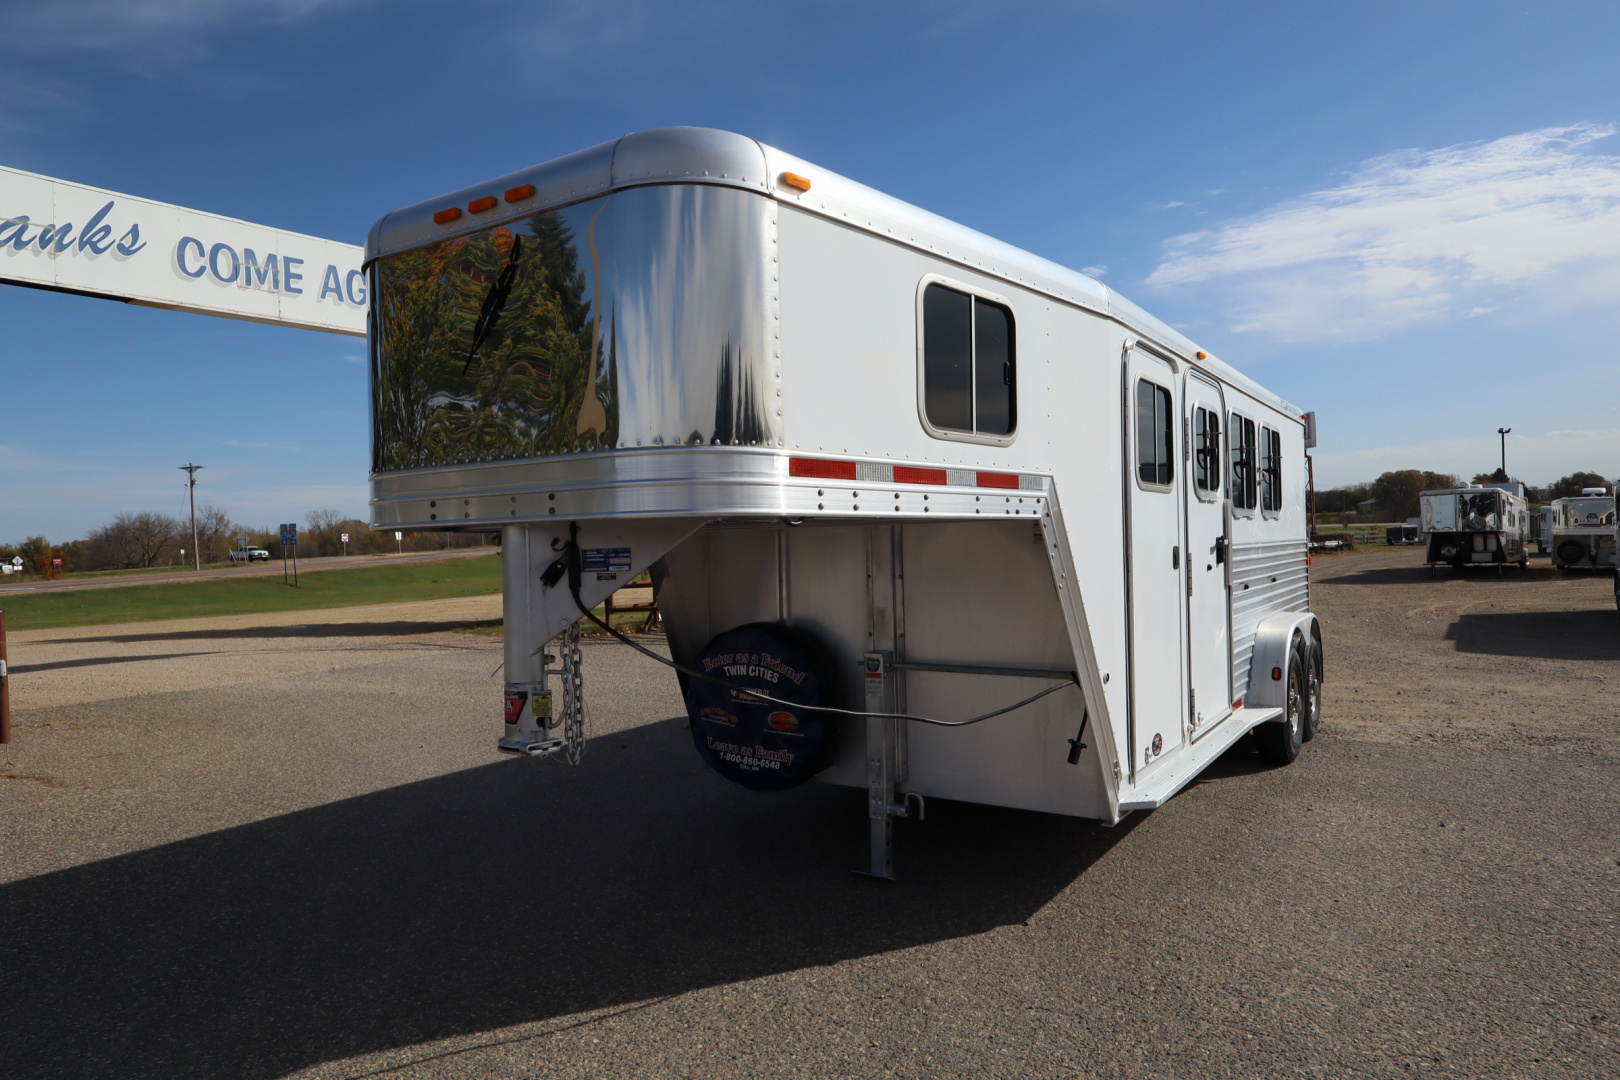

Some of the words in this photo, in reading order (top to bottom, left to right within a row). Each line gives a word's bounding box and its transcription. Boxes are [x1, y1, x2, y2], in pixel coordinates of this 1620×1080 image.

[176, 236, 304, 294] COME
[703, 654, 733, 672] Enter
[736, 652, 750, 663] as
[751, 654, 758, 664] a
[761, 652, 806, 685] Friend
[723, 665, 747, 677] TWIN
[749, 666, 779, 684] CITIES
[706, 736, 739, 754] Leave
[740, 746, 753, 756] as
[754, 745, 795, 766] Family
[719, 752, 781, 770] 1-800-860-6548
